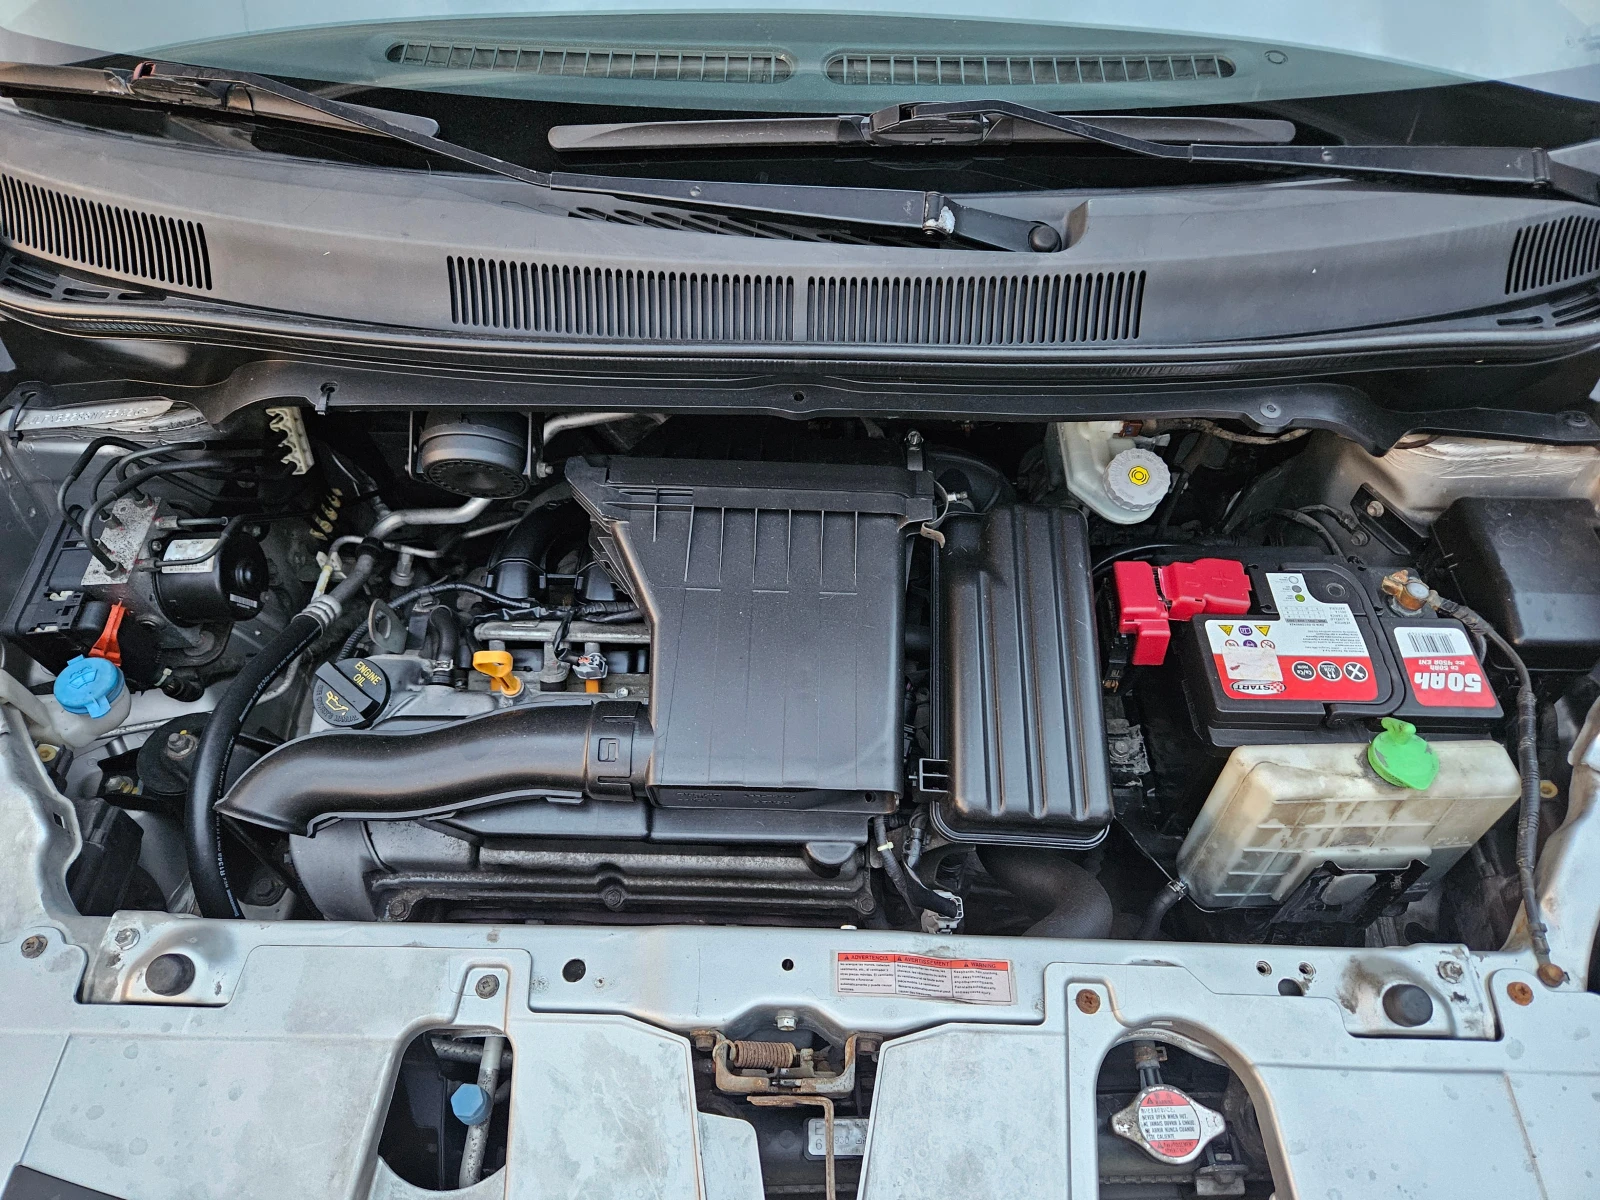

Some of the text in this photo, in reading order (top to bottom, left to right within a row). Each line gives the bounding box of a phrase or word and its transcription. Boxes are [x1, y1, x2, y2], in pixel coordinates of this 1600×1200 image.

[353, 674, 366, 688] OIL
[354, 661, 382, 686] ENGINE
[217, 852, 226, 876] R134a
[904, 956, 949, 967] AVERTISSEMENT
